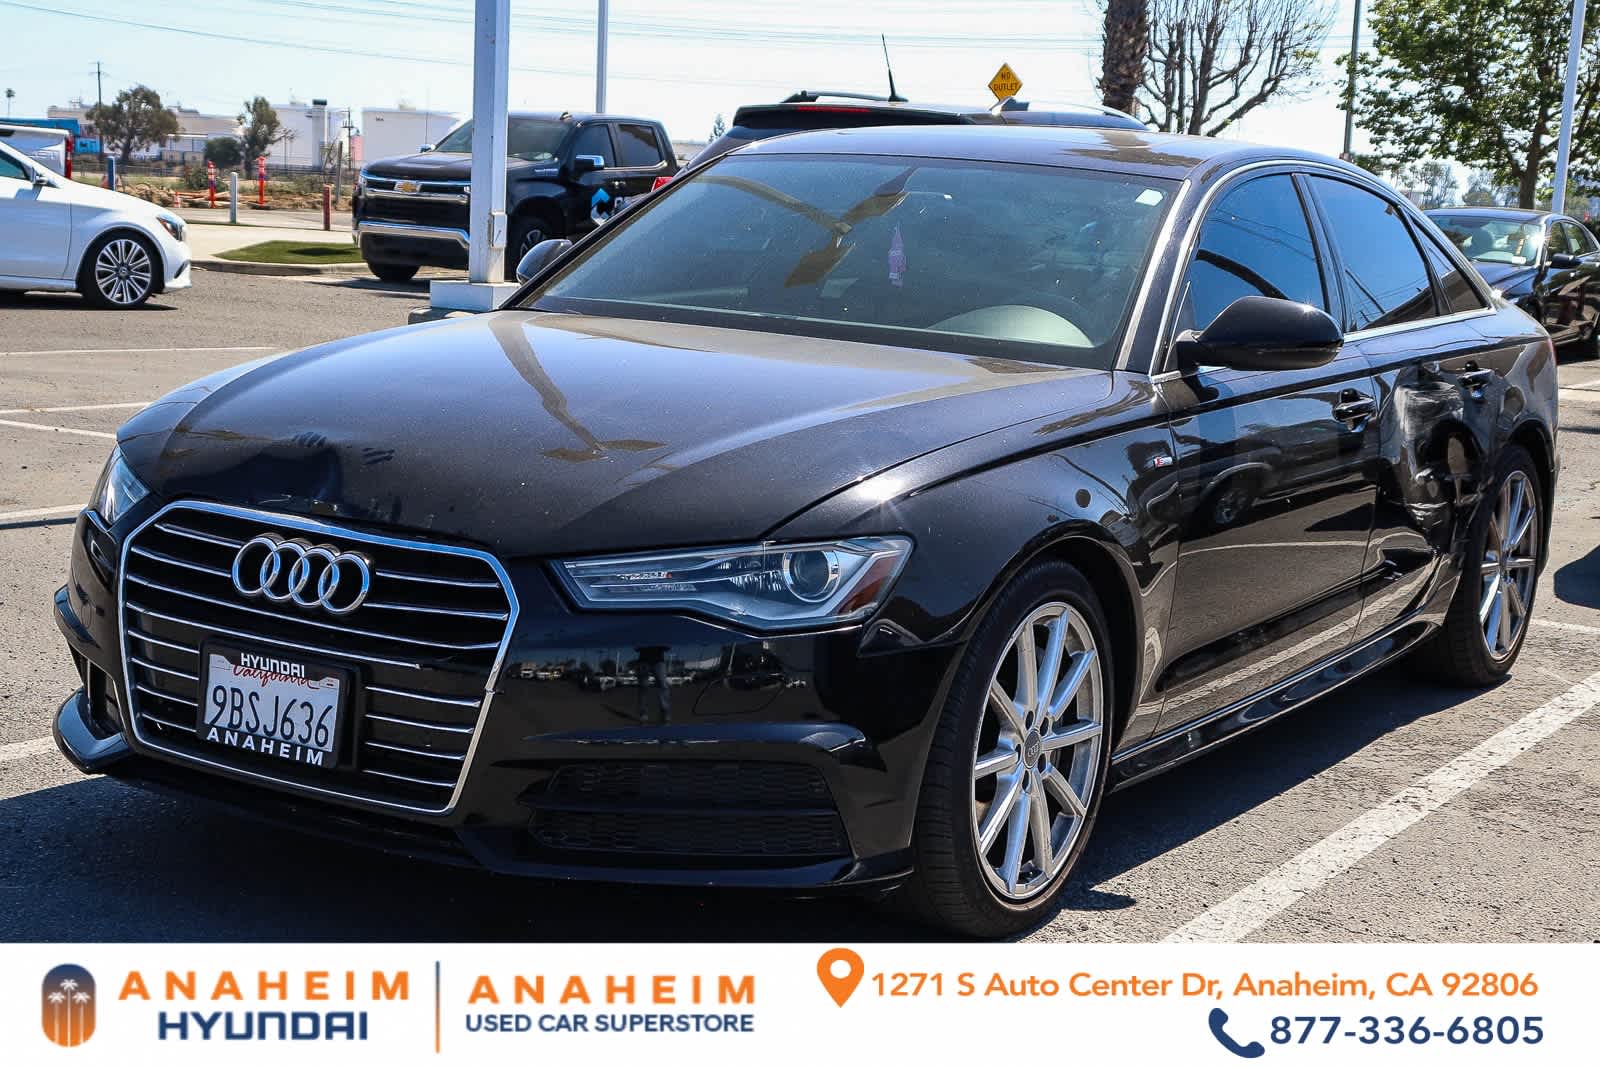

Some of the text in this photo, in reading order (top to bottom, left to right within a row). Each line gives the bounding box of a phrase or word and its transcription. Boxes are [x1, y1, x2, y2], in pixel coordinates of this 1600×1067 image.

[993, 83, 1018, 91] OUTLET
[1001, 72, 1011, 80] NO
[241, 652, 305, 678] HYUNDAI
[210, 685, 333, 748] 9BSJ636
[207, 727, 324, 767] ANAHEIM
